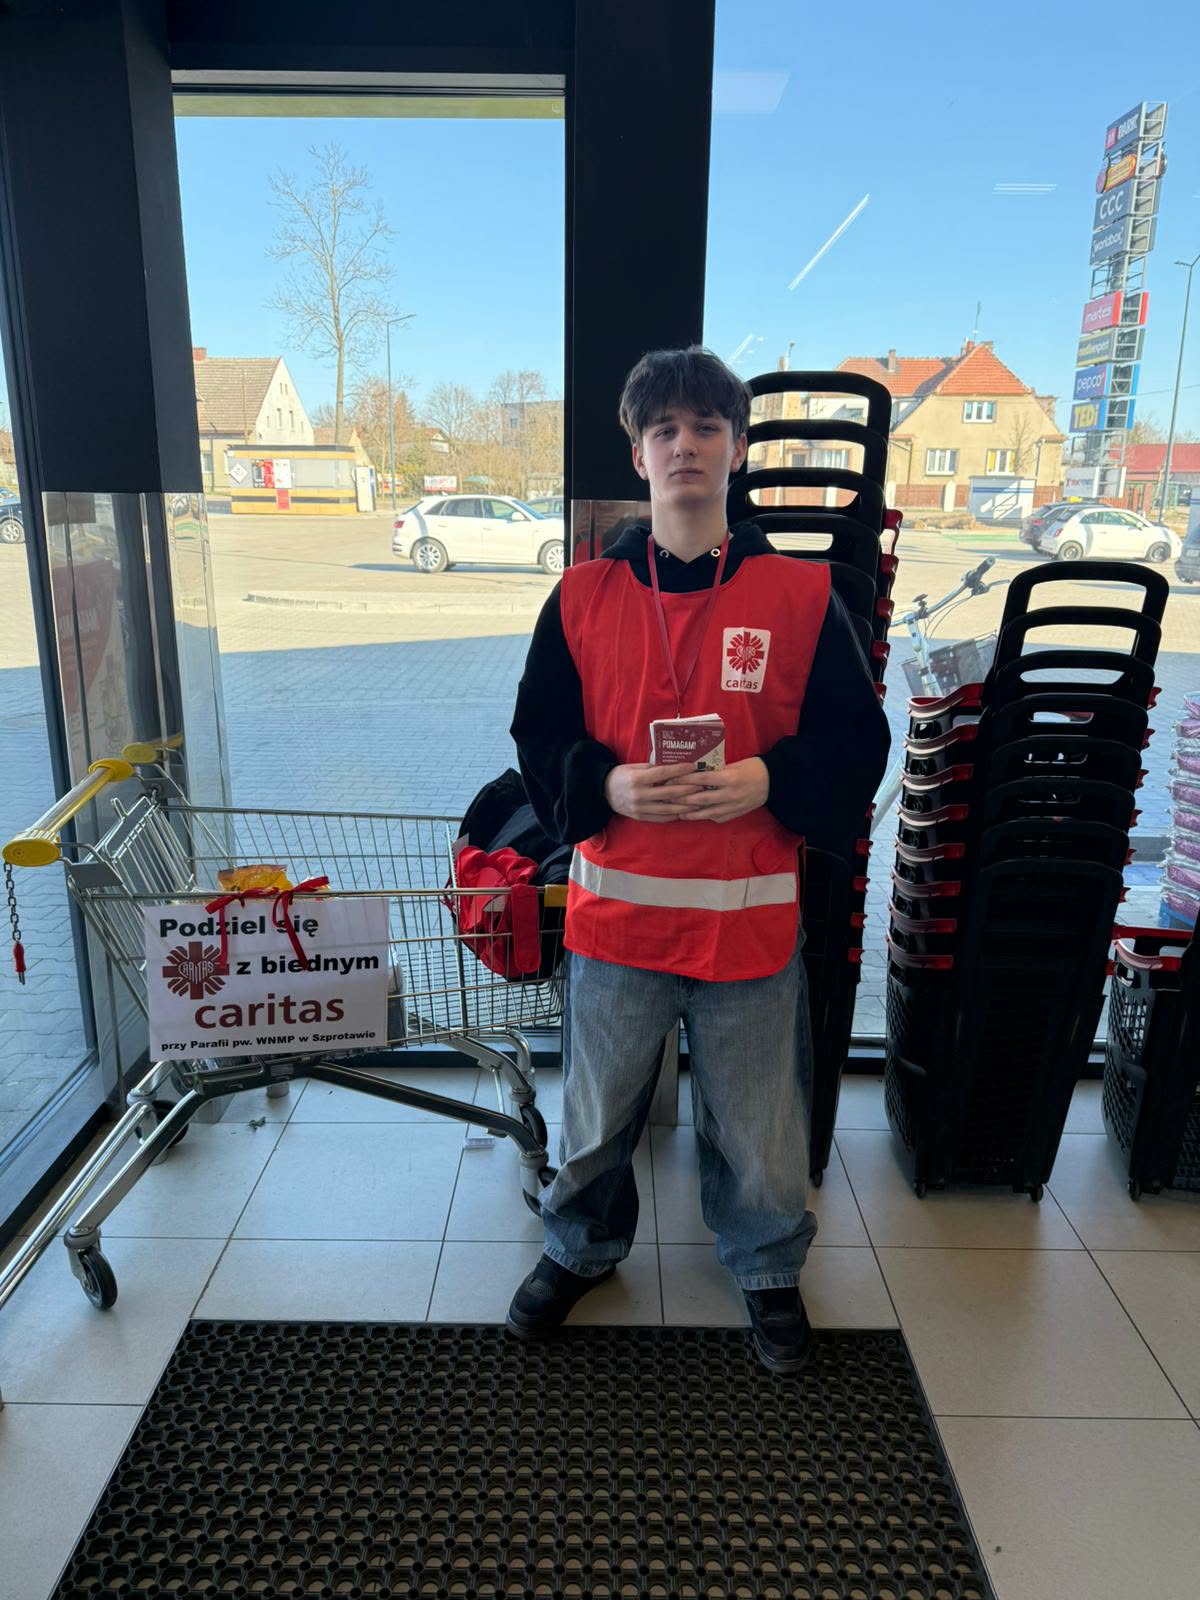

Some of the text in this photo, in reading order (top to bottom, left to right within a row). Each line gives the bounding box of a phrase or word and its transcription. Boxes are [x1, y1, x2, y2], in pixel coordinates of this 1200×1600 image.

[1100, 190, 1124, 219] CCC
[1076, 374, 1103, 394] pepco
[160, 915, 319, 938] Podziel się
[236, 954, 379, 975] z biednym
[194, 993, 345, 1030] caritas
[161, 1041, 187, 1052] przy
[190, 1038, 229, 1050] Parafii
[232, 1039, 252, 1049] pw.
[256, 1035, 295, 1046] WNMP
[312, 1030, 376, 1045] Szprotawie
